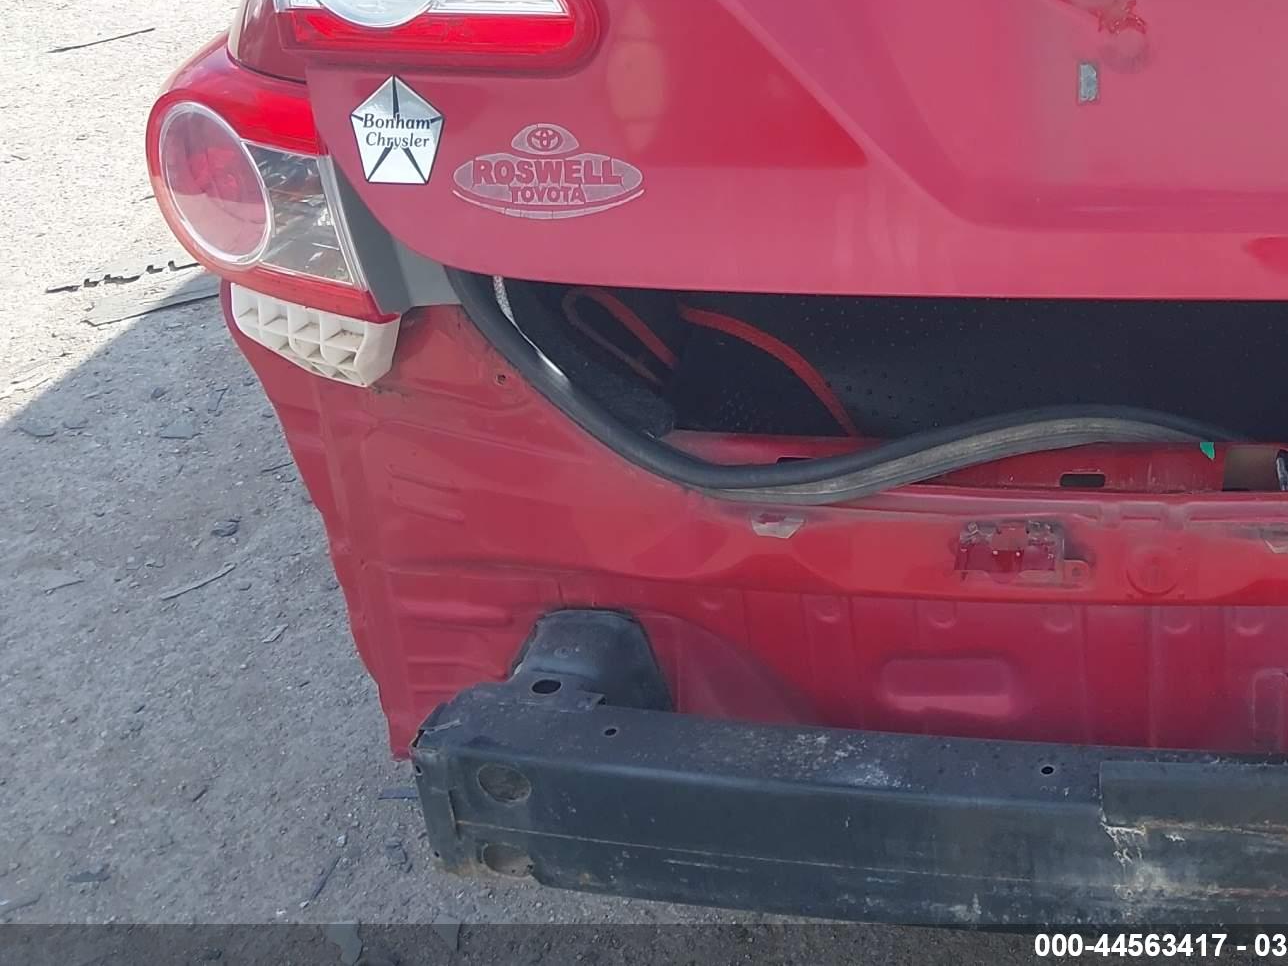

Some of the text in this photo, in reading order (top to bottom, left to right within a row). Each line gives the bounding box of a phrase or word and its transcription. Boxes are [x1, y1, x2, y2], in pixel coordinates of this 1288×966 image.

[362, 113, 431, 129] Bonham
[365, 132, 430, 150] Chrysler
[473, 159, 623, 185] ROSWELL
[510, 185, 586, 203] TOYOTA
